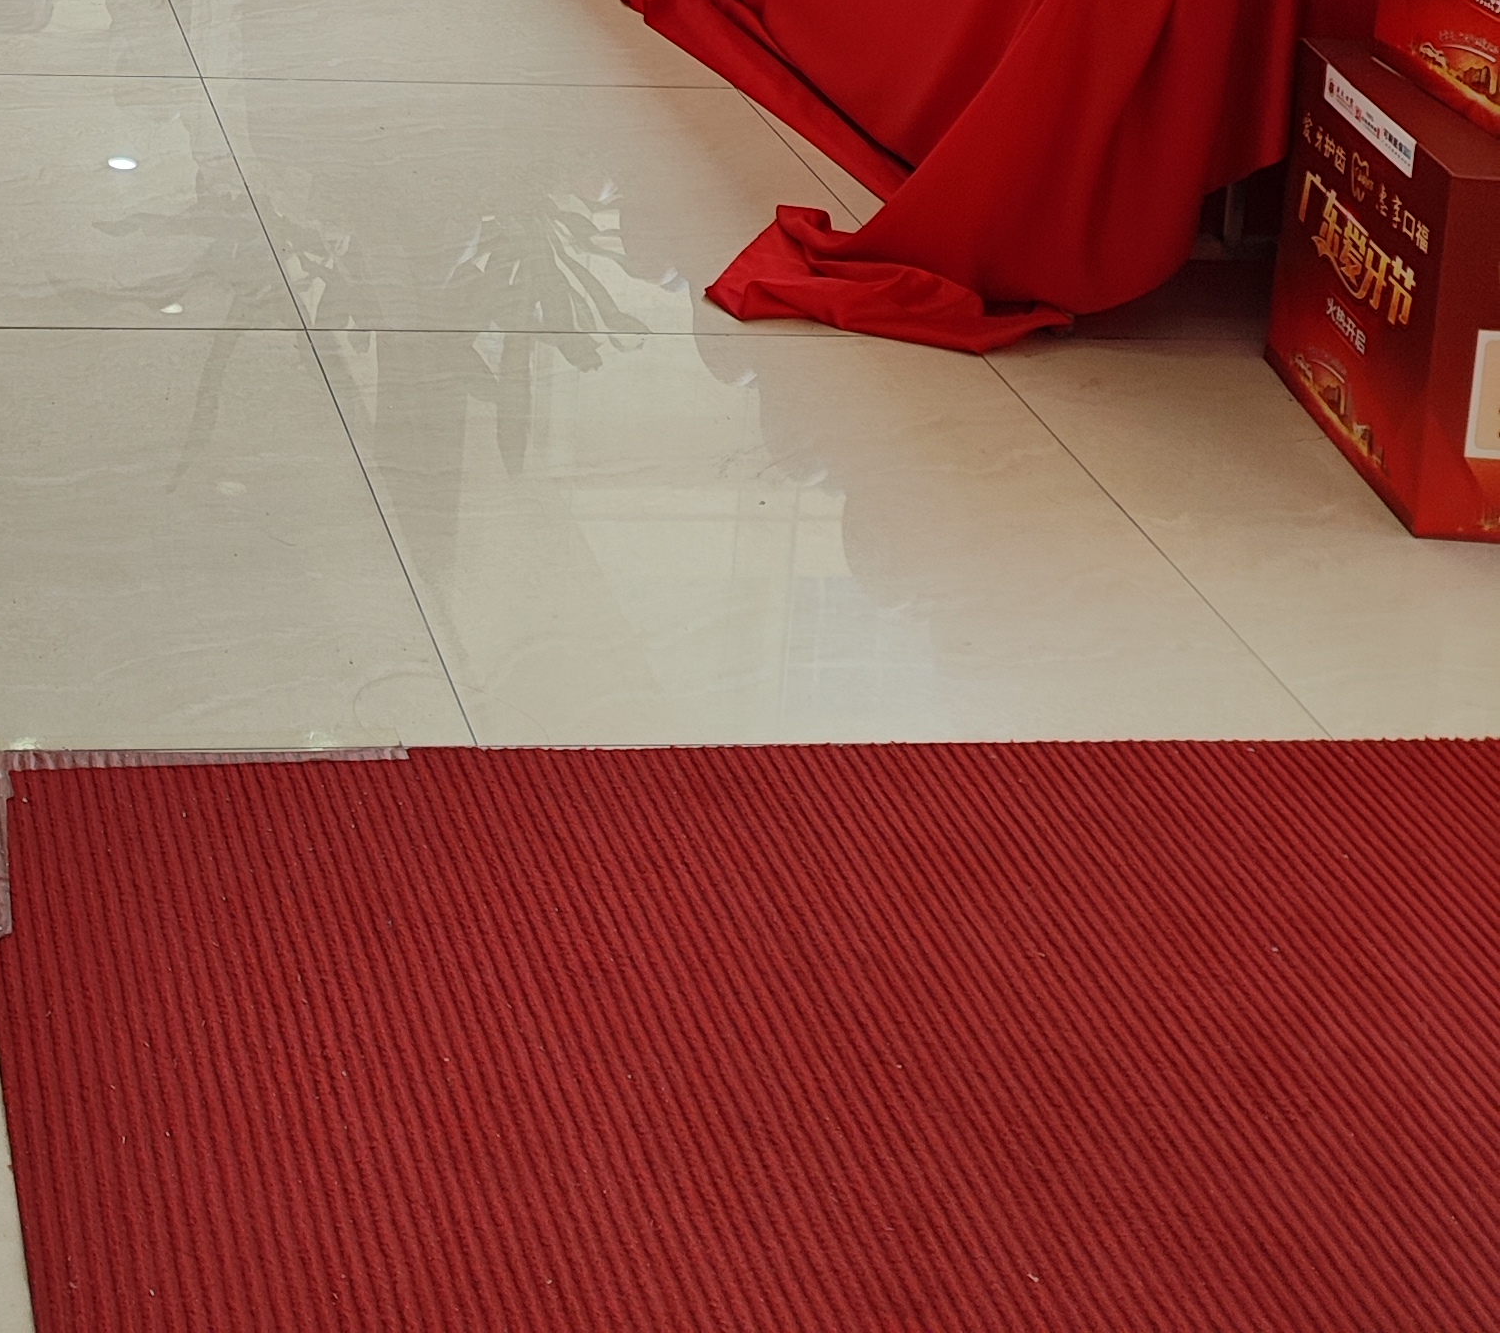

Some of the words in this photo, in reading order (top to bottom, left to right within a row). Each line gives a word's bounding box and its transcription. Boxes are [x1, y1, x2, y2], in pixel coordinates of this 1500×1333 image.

[1299, 169, 1417, 327] 广东爱牙节
[1325, 296, 1367, 356] 火热开启
